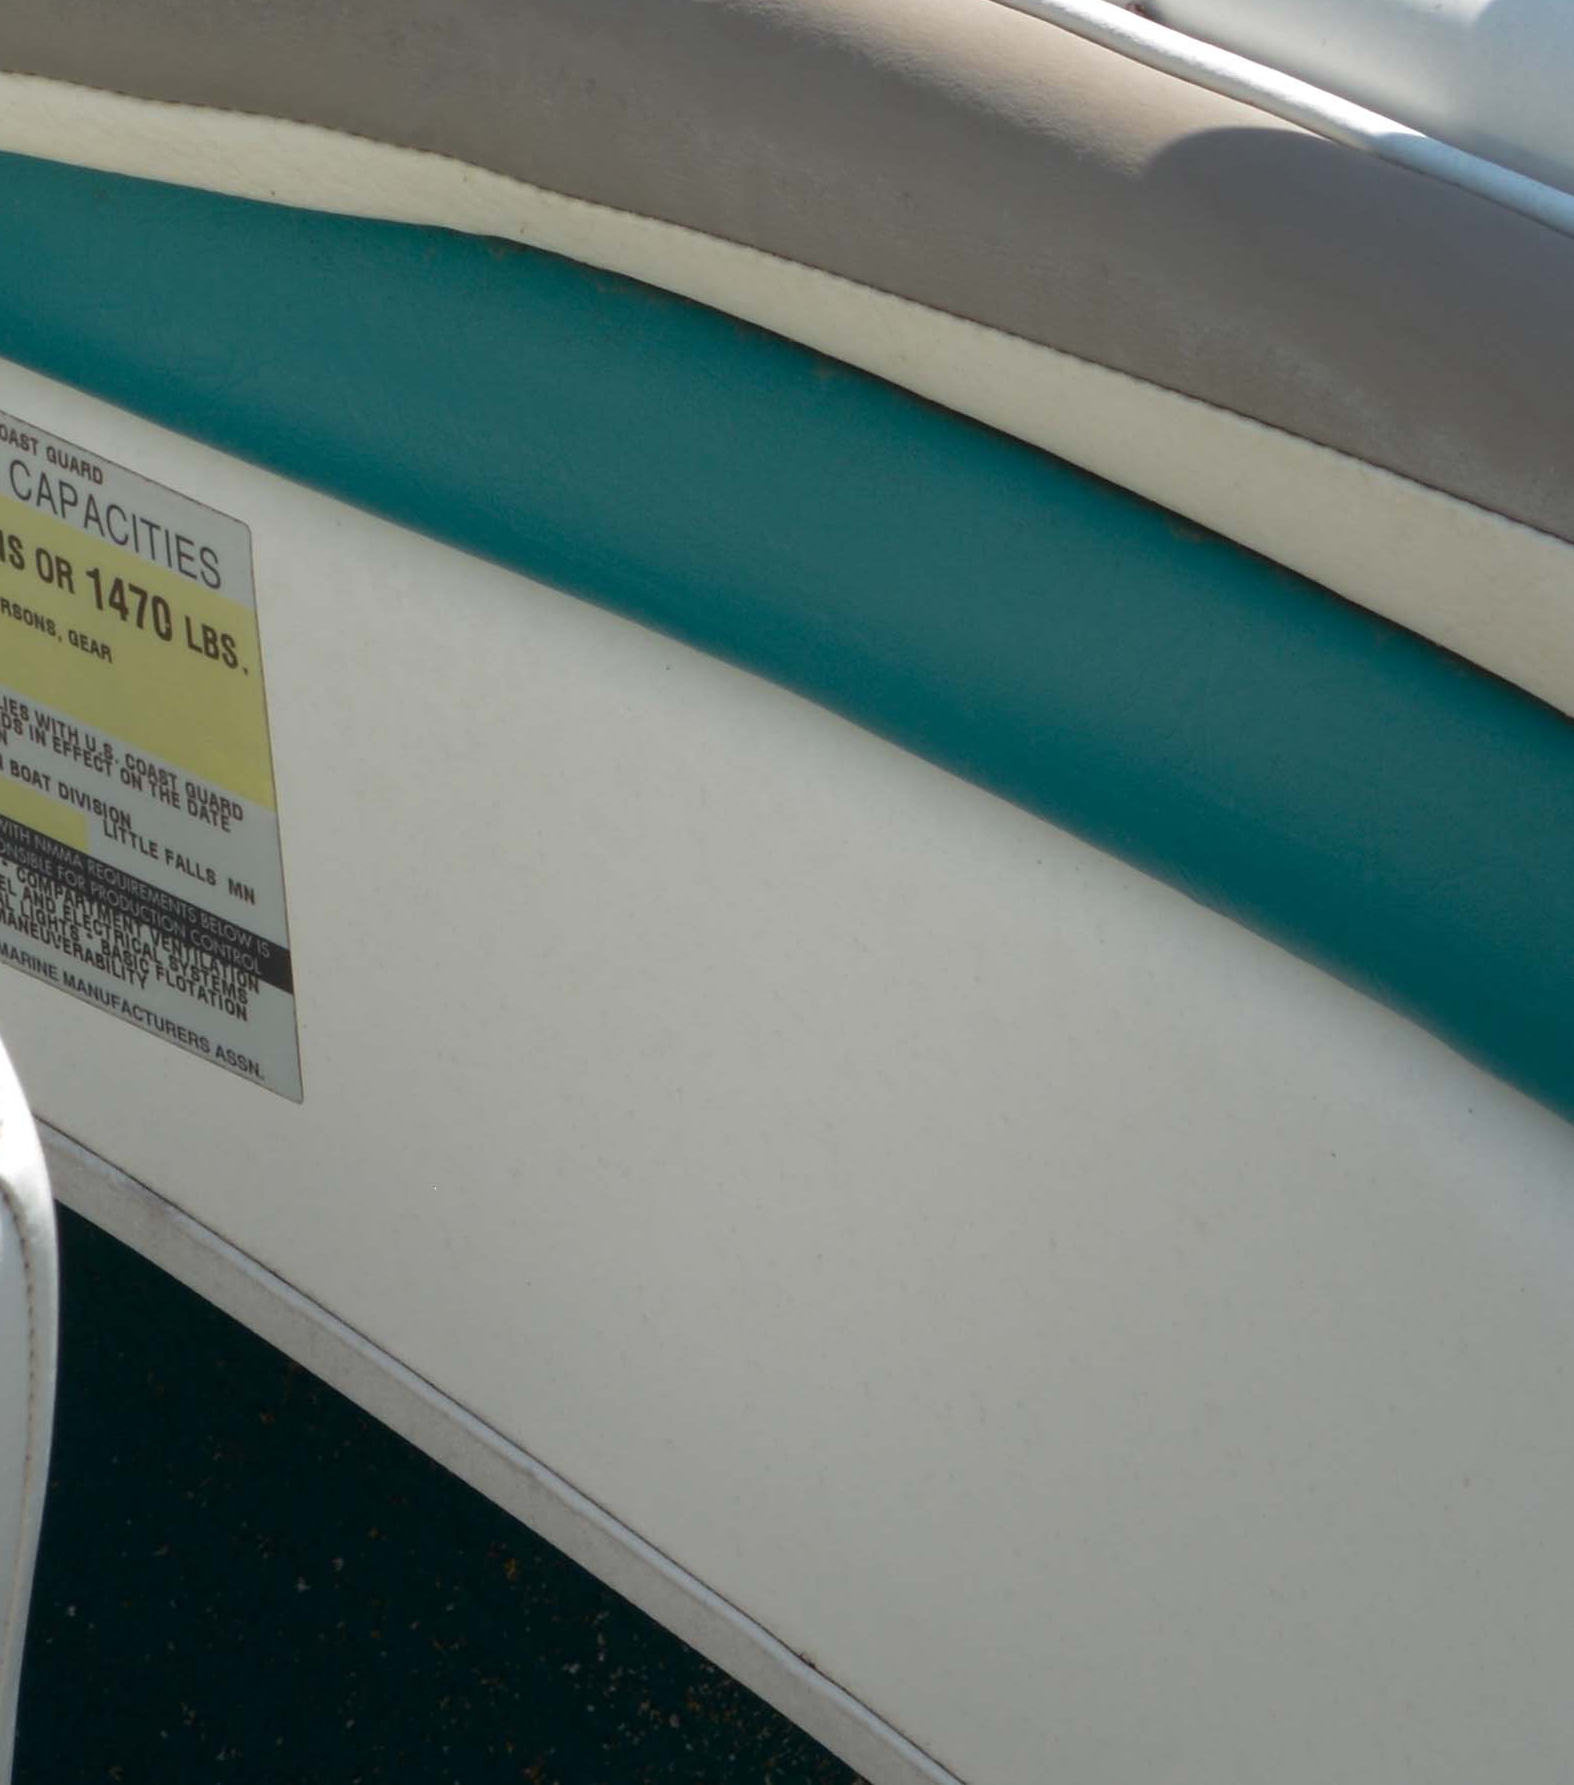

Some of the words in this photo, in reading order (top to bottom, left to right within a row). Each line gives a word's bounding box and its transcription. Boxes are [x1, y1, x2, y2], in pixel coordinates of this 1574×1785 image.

[44, 443, 104, 488] GUARD
[7, 454, 223, 593] CAPACITIES
[33, 544, 76, 597] OR
[84, 561, 175, 646] 1470
[183, 612, 249, 678] LBS.
[66, 625, 113, 665] GEAR
[9, 757, 52, 795] BOAT
[57, 780, 133, 832] DIVISION
[28, 723, 46, 748] IN
[51, 734, 114, 779] EFFECT
[119, 765, 142, 792] ON
[147, 778, 182, 811] THE
[186, 796, 232, 835] DATE
[33, 708, 80, 747] WITH
[123, 750, 178, 793] COAST
[182, 777, 245, 824] GUARD
[85, 857, 198, 926] REQUIREMENTS
[198, 910, 253, 951] BELOW
[255, 936, 271, 960] IS
[102, 817, 159, 862] LITTLE
[163, 846, 218, 889] FALLS
[226, 875, 257, 908] MN
[14, 862, 143, 940] COMPARTMENT
[148, 924, 261, 996] VENTILATION
[19, 898, 80, 944] LIGHTS
[99, 936, 150, 977] BASIC
[153, 962, 248, 1024] FLOTATION
[20, 882, 57, 917] AND
[60, 901, 162, 966] ELECTRICAL
[167, 952, 250, 1008] SYSTEMS
[56, 863, 85, 893] FOR
[89, 880, 187, 941] PRODUCTION
[188, 926, 262, 976] CONTROL
[61, 969, 211, 1056] MANUFACTURERS
[213, 1041, 265, 1082] ASSN.
